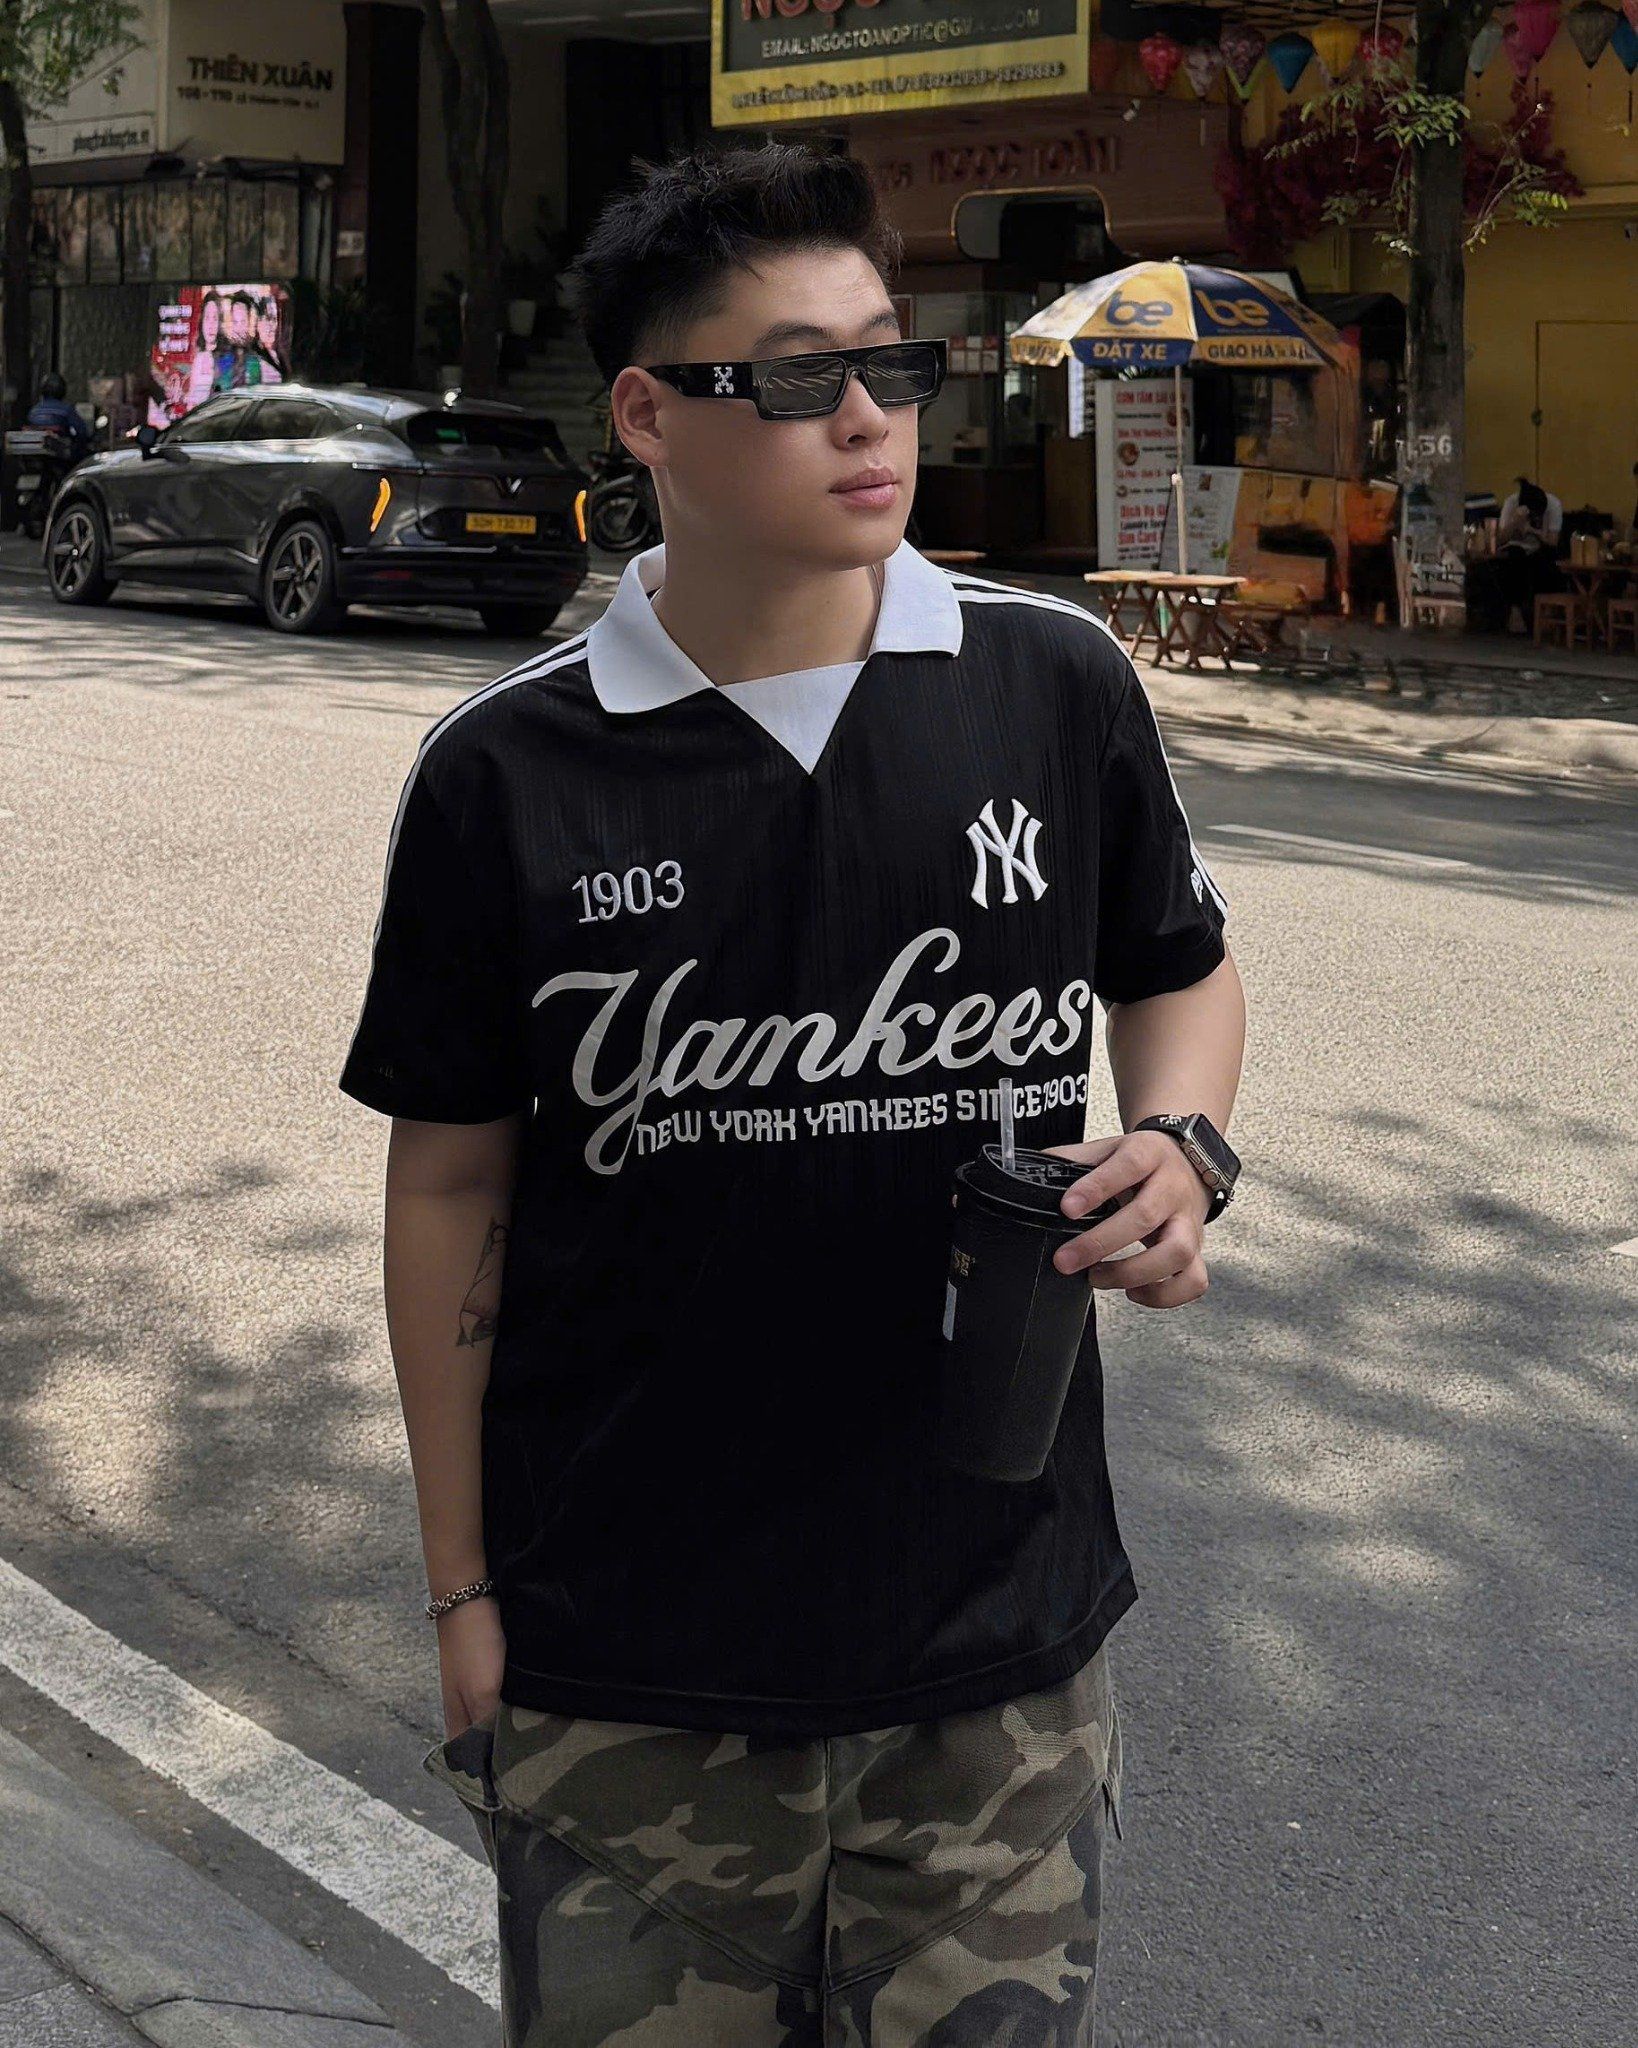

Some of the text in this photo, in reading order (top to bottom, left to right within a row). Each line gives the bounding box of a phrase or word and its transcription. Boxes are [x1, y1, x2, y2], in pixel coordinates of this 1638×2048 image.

[187, 53, 334, 91] THIÊN XUÂN
[1105, 291, 1172, 326] be
[1195, 289, 1270, 328] be
[1092, 340, 1167, 365] ĐẶT XE
[1208, 343, 1248, 360] GIAO
[571, 860, 686, 923] 1903
[532, 927, 1092, 1175] Yankees
[636, 1110, 700, 1155] NEW
[709, 1108, 796, 1142] YORK
[803, 1092, 947, 1136] YANKEES
[1043, 1073, 1088, 1112] 1903
